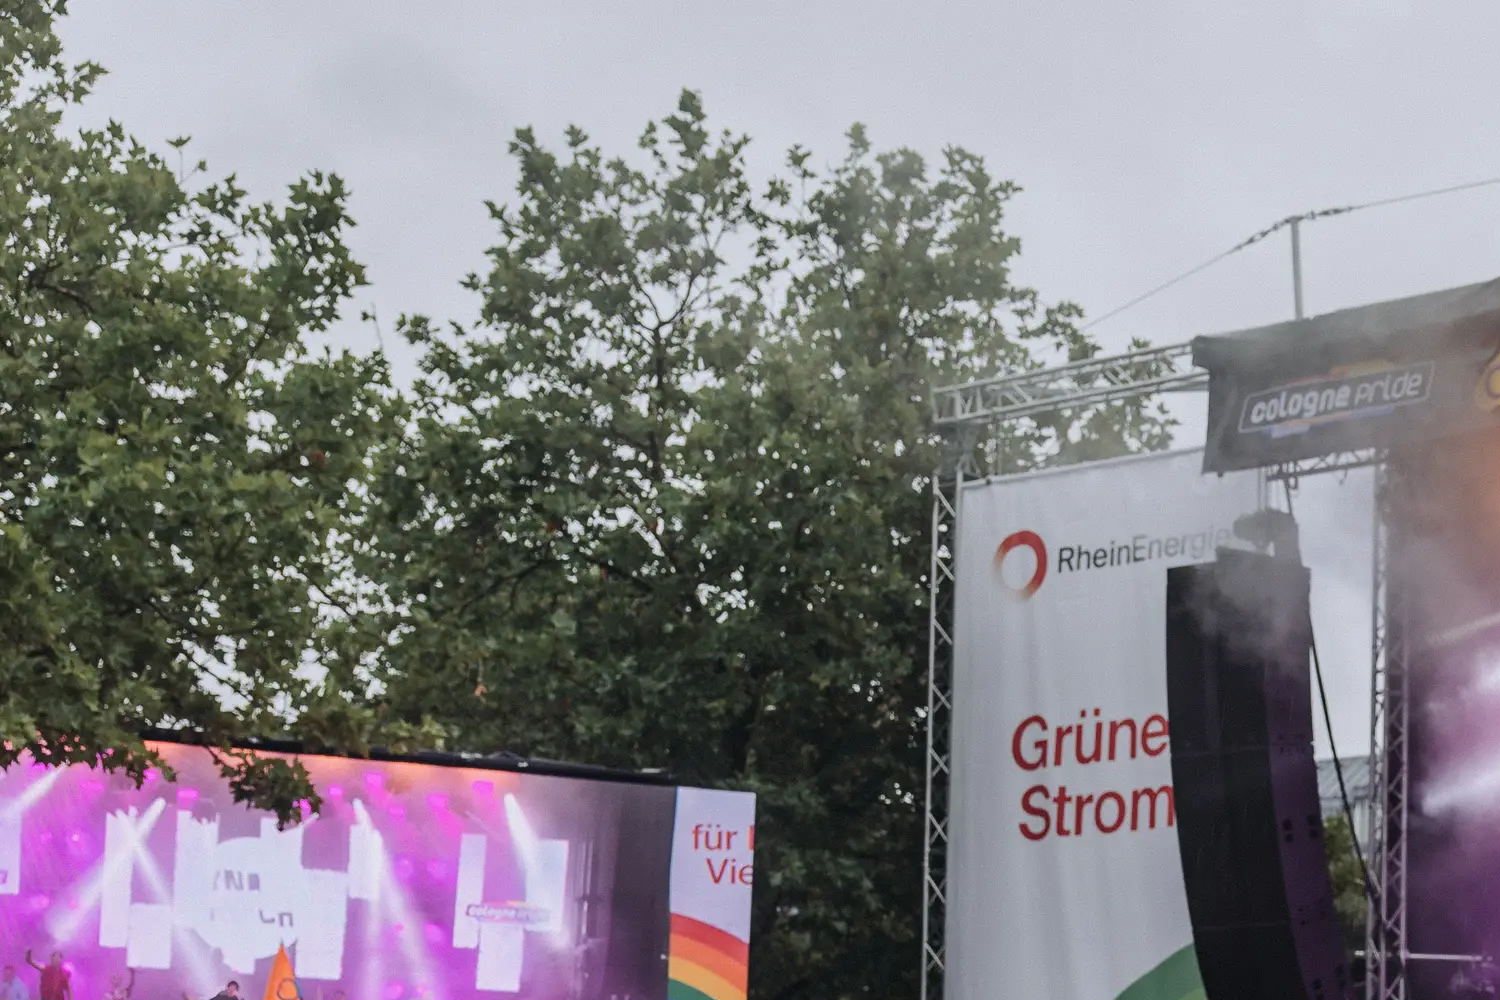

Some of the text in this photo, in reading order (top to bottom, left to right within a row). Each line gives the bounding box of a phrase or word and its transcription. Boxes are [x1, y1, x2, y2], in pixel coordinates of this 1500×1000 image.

[1250, 372, 1422, 424] cologne pride
[1012, 708, 1169, 771] Grüne
[692, 823, 738, 850] für
[1019, 784, 1175, 841] Strom
